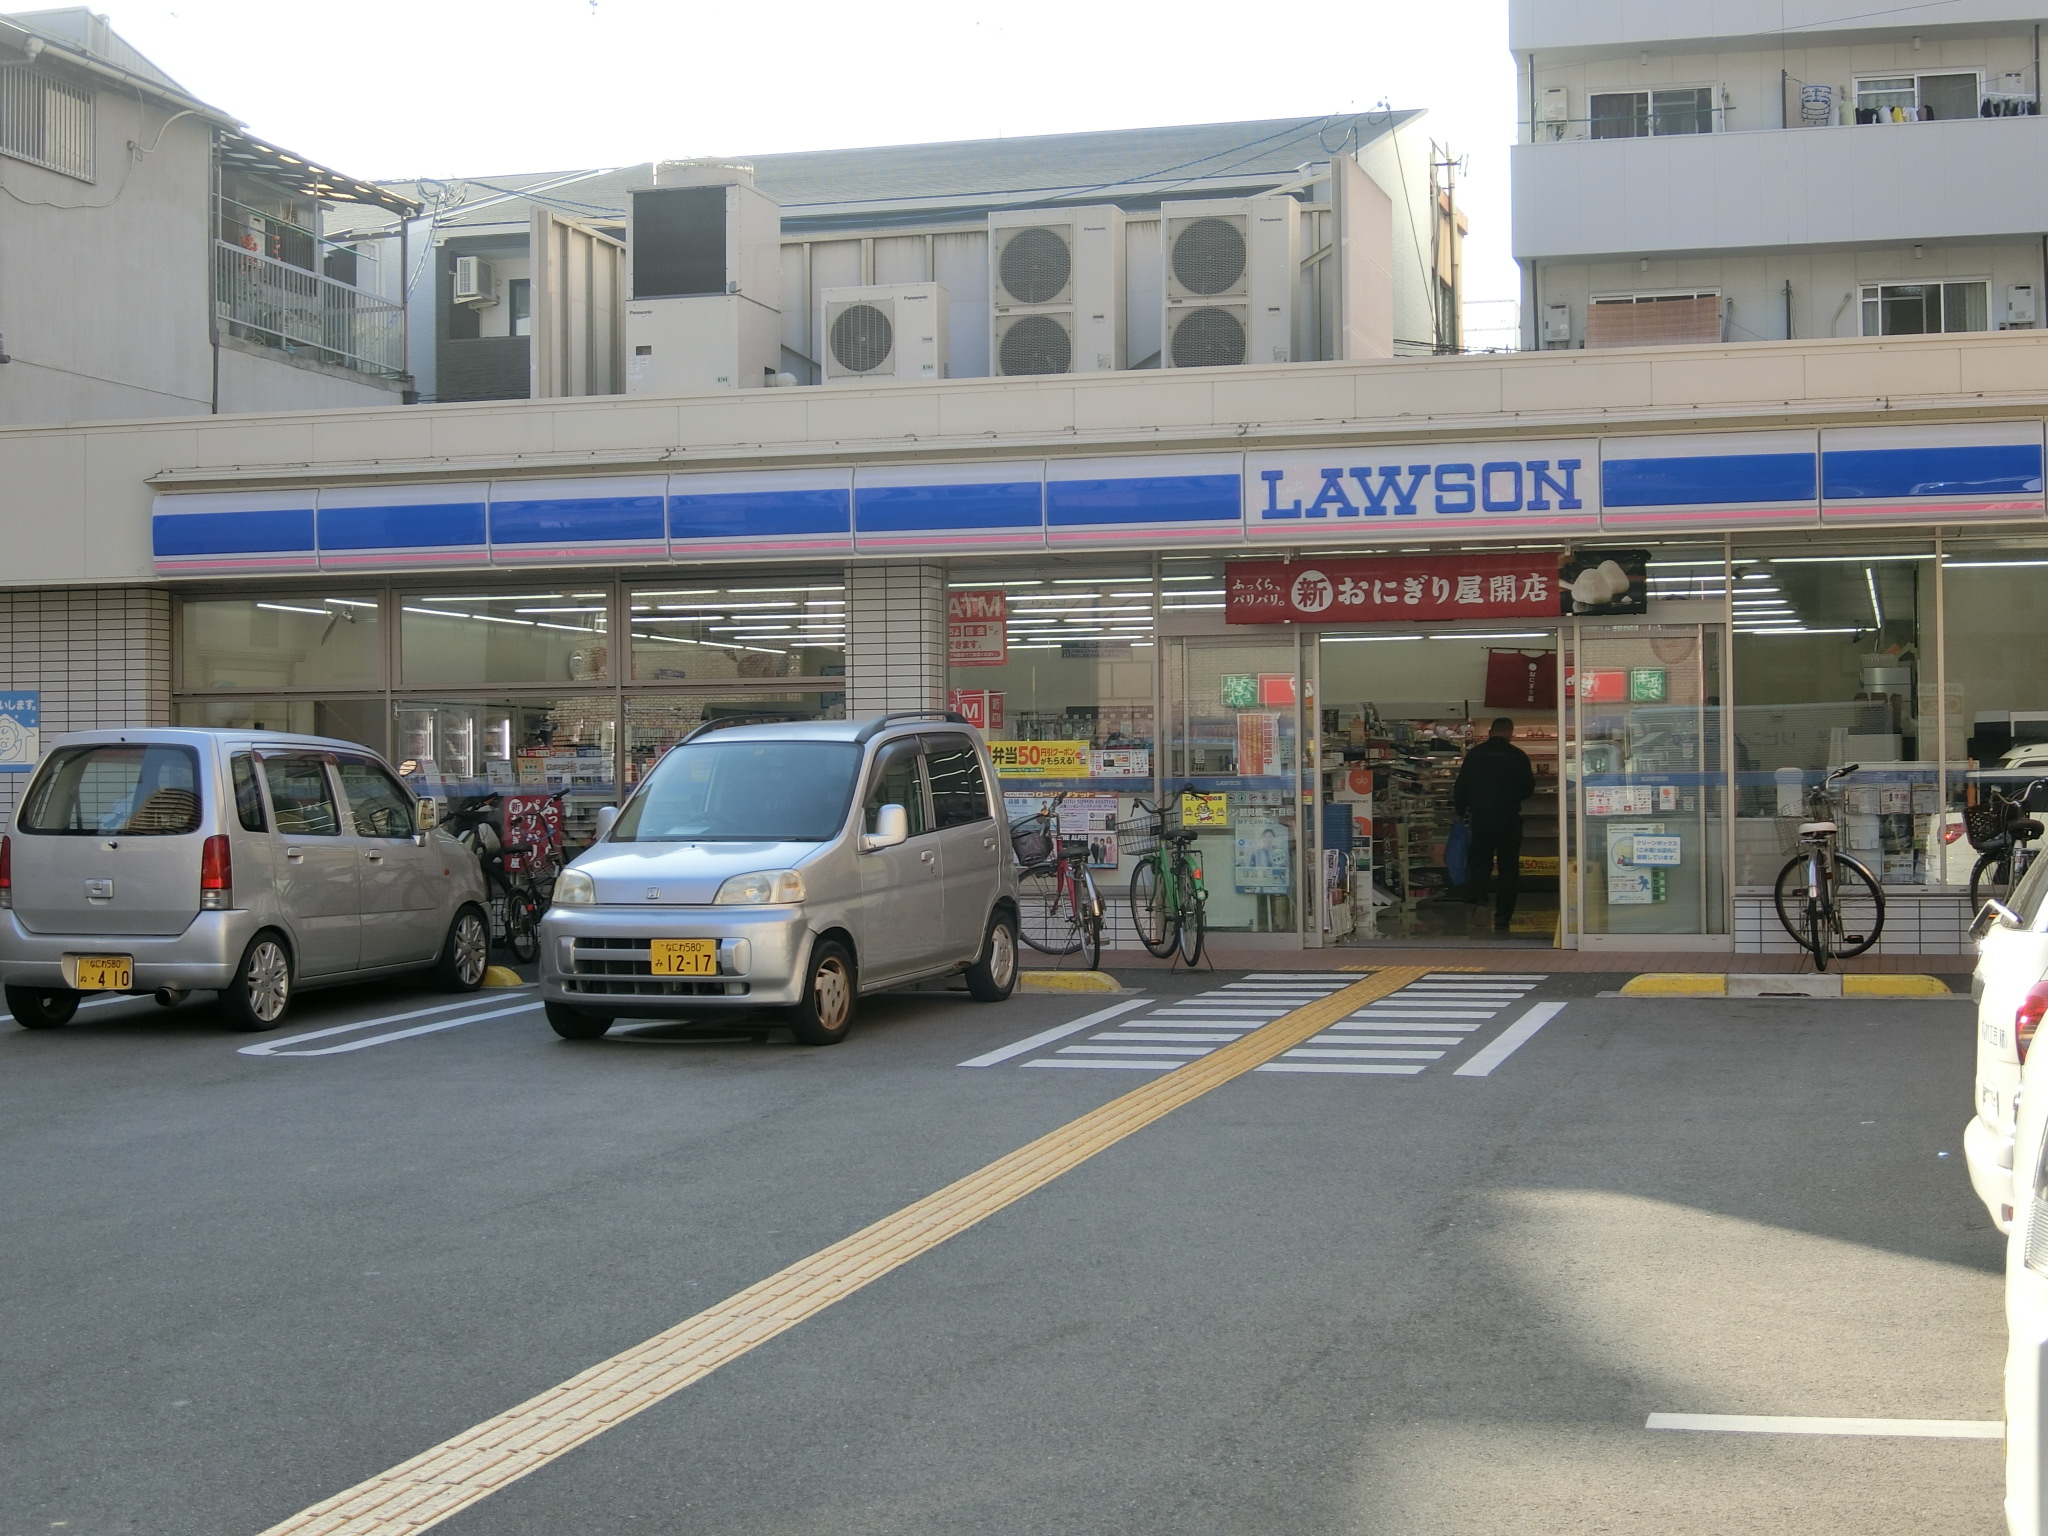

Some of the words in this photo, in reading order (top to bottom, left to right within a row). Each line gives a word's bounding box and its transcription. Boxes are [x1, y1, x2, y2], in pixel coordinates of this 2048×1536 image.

[1261, 458, 1583, 520] LAWSON
[1232, 578, 1281, 591] ふっくら、
[949, 595, 1000, 617] ATM
[1232, 593, 1285, 606] パリパリ。
[666, 942, 702, 952] なにわ580
[90, 959, 121, 968] なにわ580
[668, 954, 712, 972] 12-17
